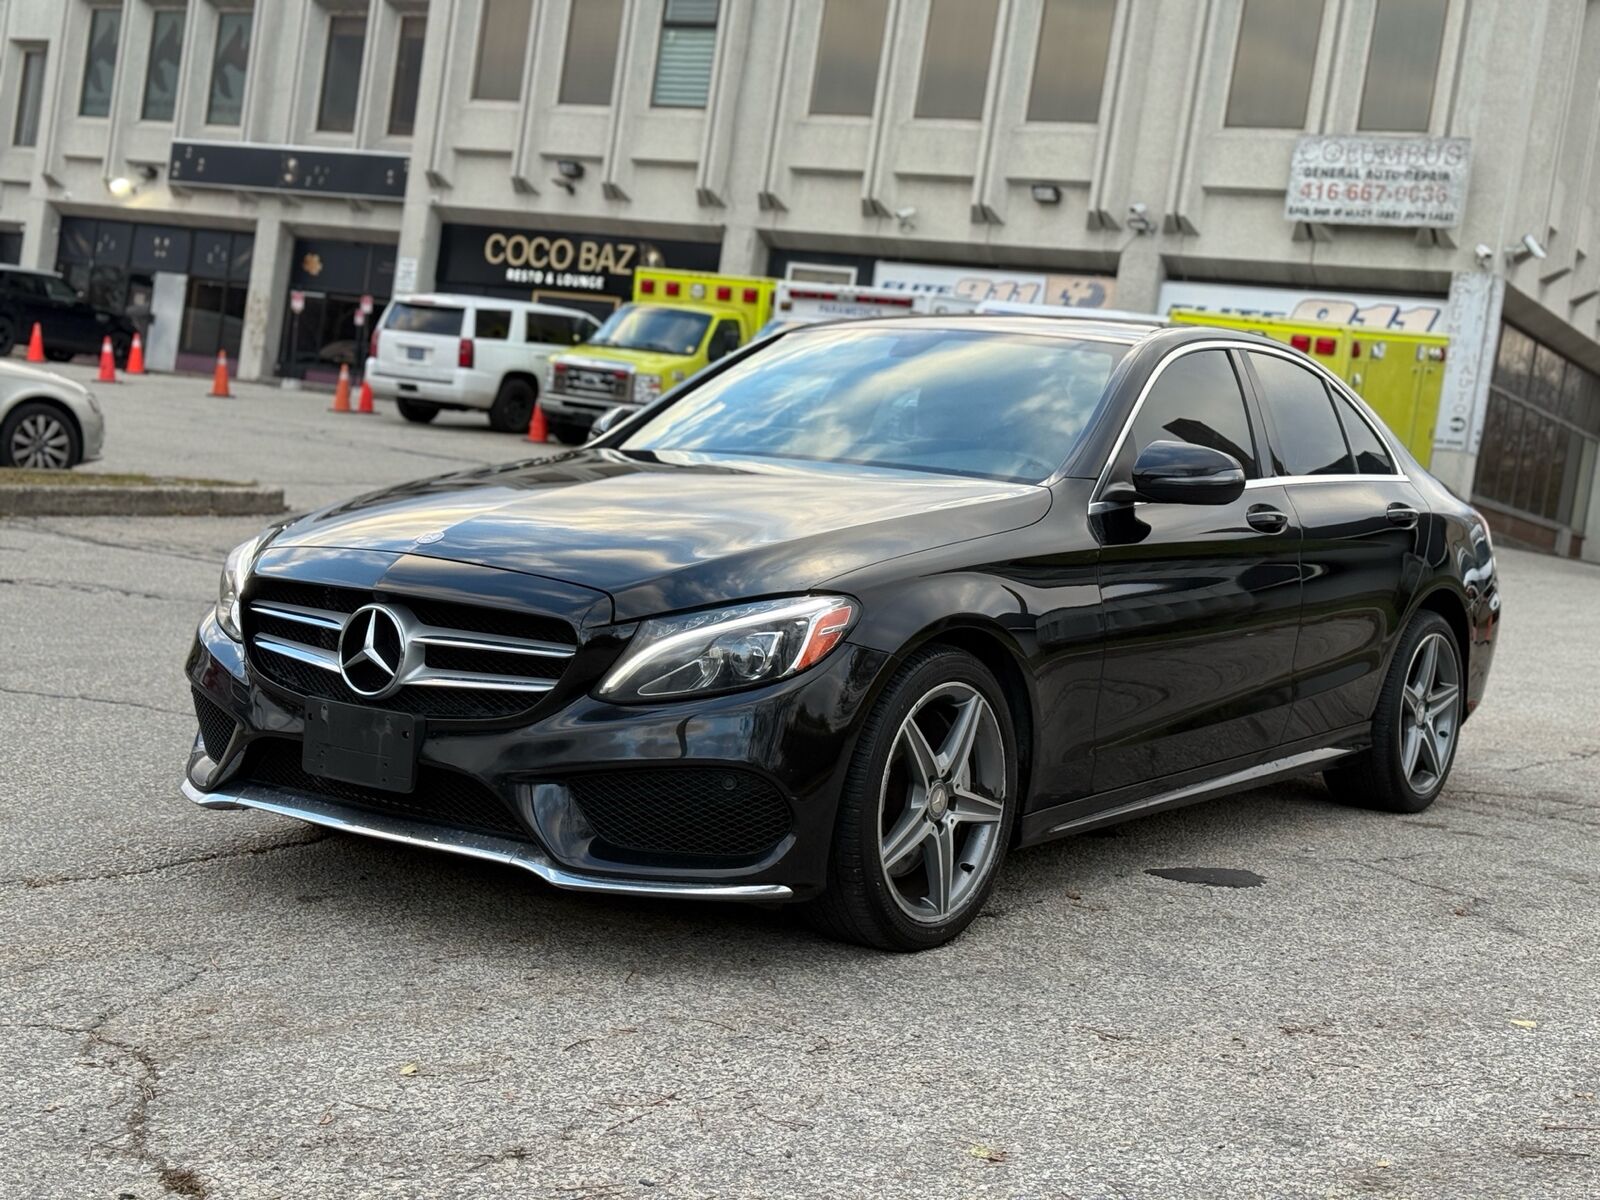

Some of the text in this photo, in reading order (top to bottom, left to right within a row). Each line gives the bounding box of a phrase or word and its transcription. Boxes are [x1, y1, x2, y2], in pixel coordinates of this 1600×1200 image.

[1303, 167, 1360, 180] GENERAL
[484, 233, 636, 275] COCO BAZ
[505, 268, 605, 291] RESTO & LOUNGE
